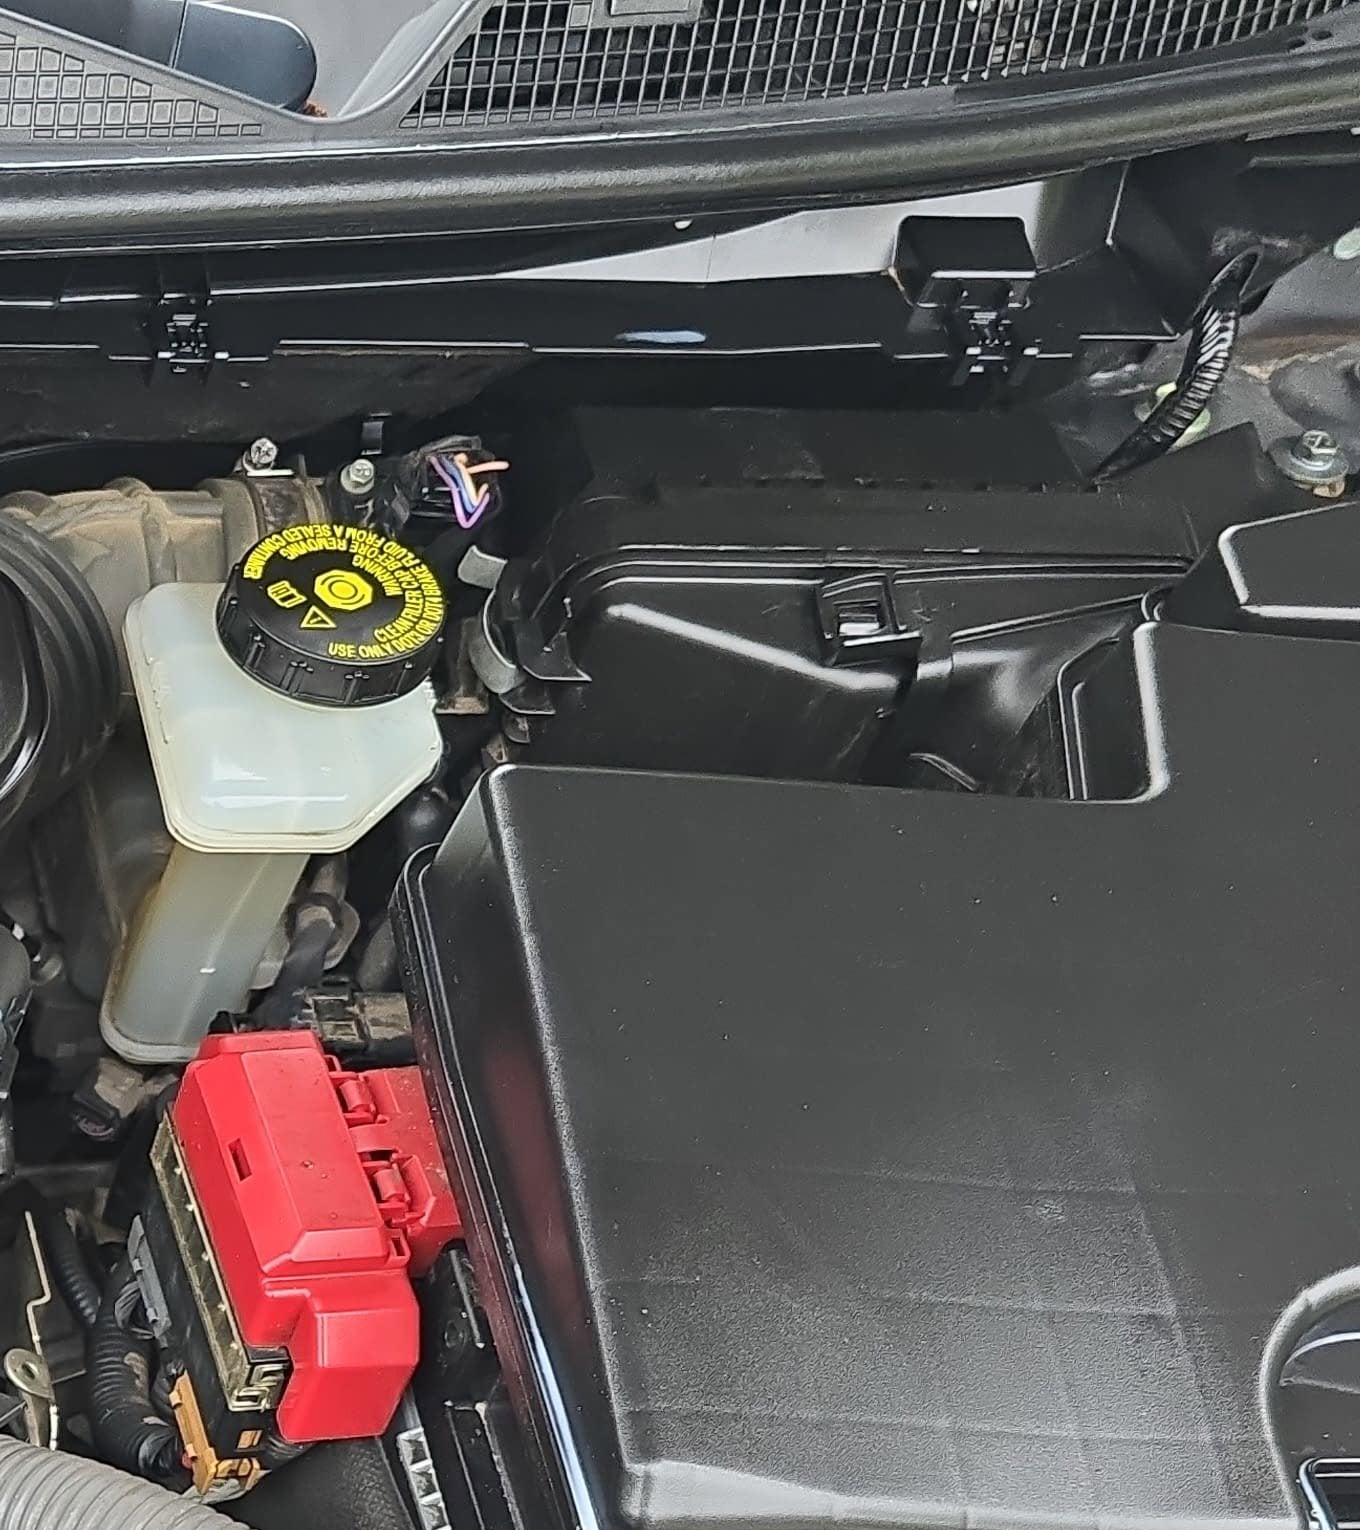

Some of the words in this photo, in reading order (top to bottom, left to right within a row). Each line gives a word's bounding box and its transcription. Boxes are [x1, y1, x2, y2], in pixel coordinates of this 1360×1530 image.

[282, 524, 332, 542] SEALED
[332, 524, 344, 538] A
[345, 526, 386, 548] FROM
[279, 537, 348, 560] REMOVING
[349, 540, 402, 571] BEFORE
[383, 541, 421, 567] FLUID
[352, 554, 403, 596] WARNING
[393, 569, 420, 589] CAP
[409, 563, 442, 596] BRAKE
[401, 590, 423, 622] FILLER
[421, 597, 444, 621] DOT4
[374, 617, 414, 642] CLEAN
[415, 619, 438, 635] OR
[328, 642, 357, 658] USE
[358, 642, 395, 658] ONLY
[391, 630, 425, 652] DOT3
